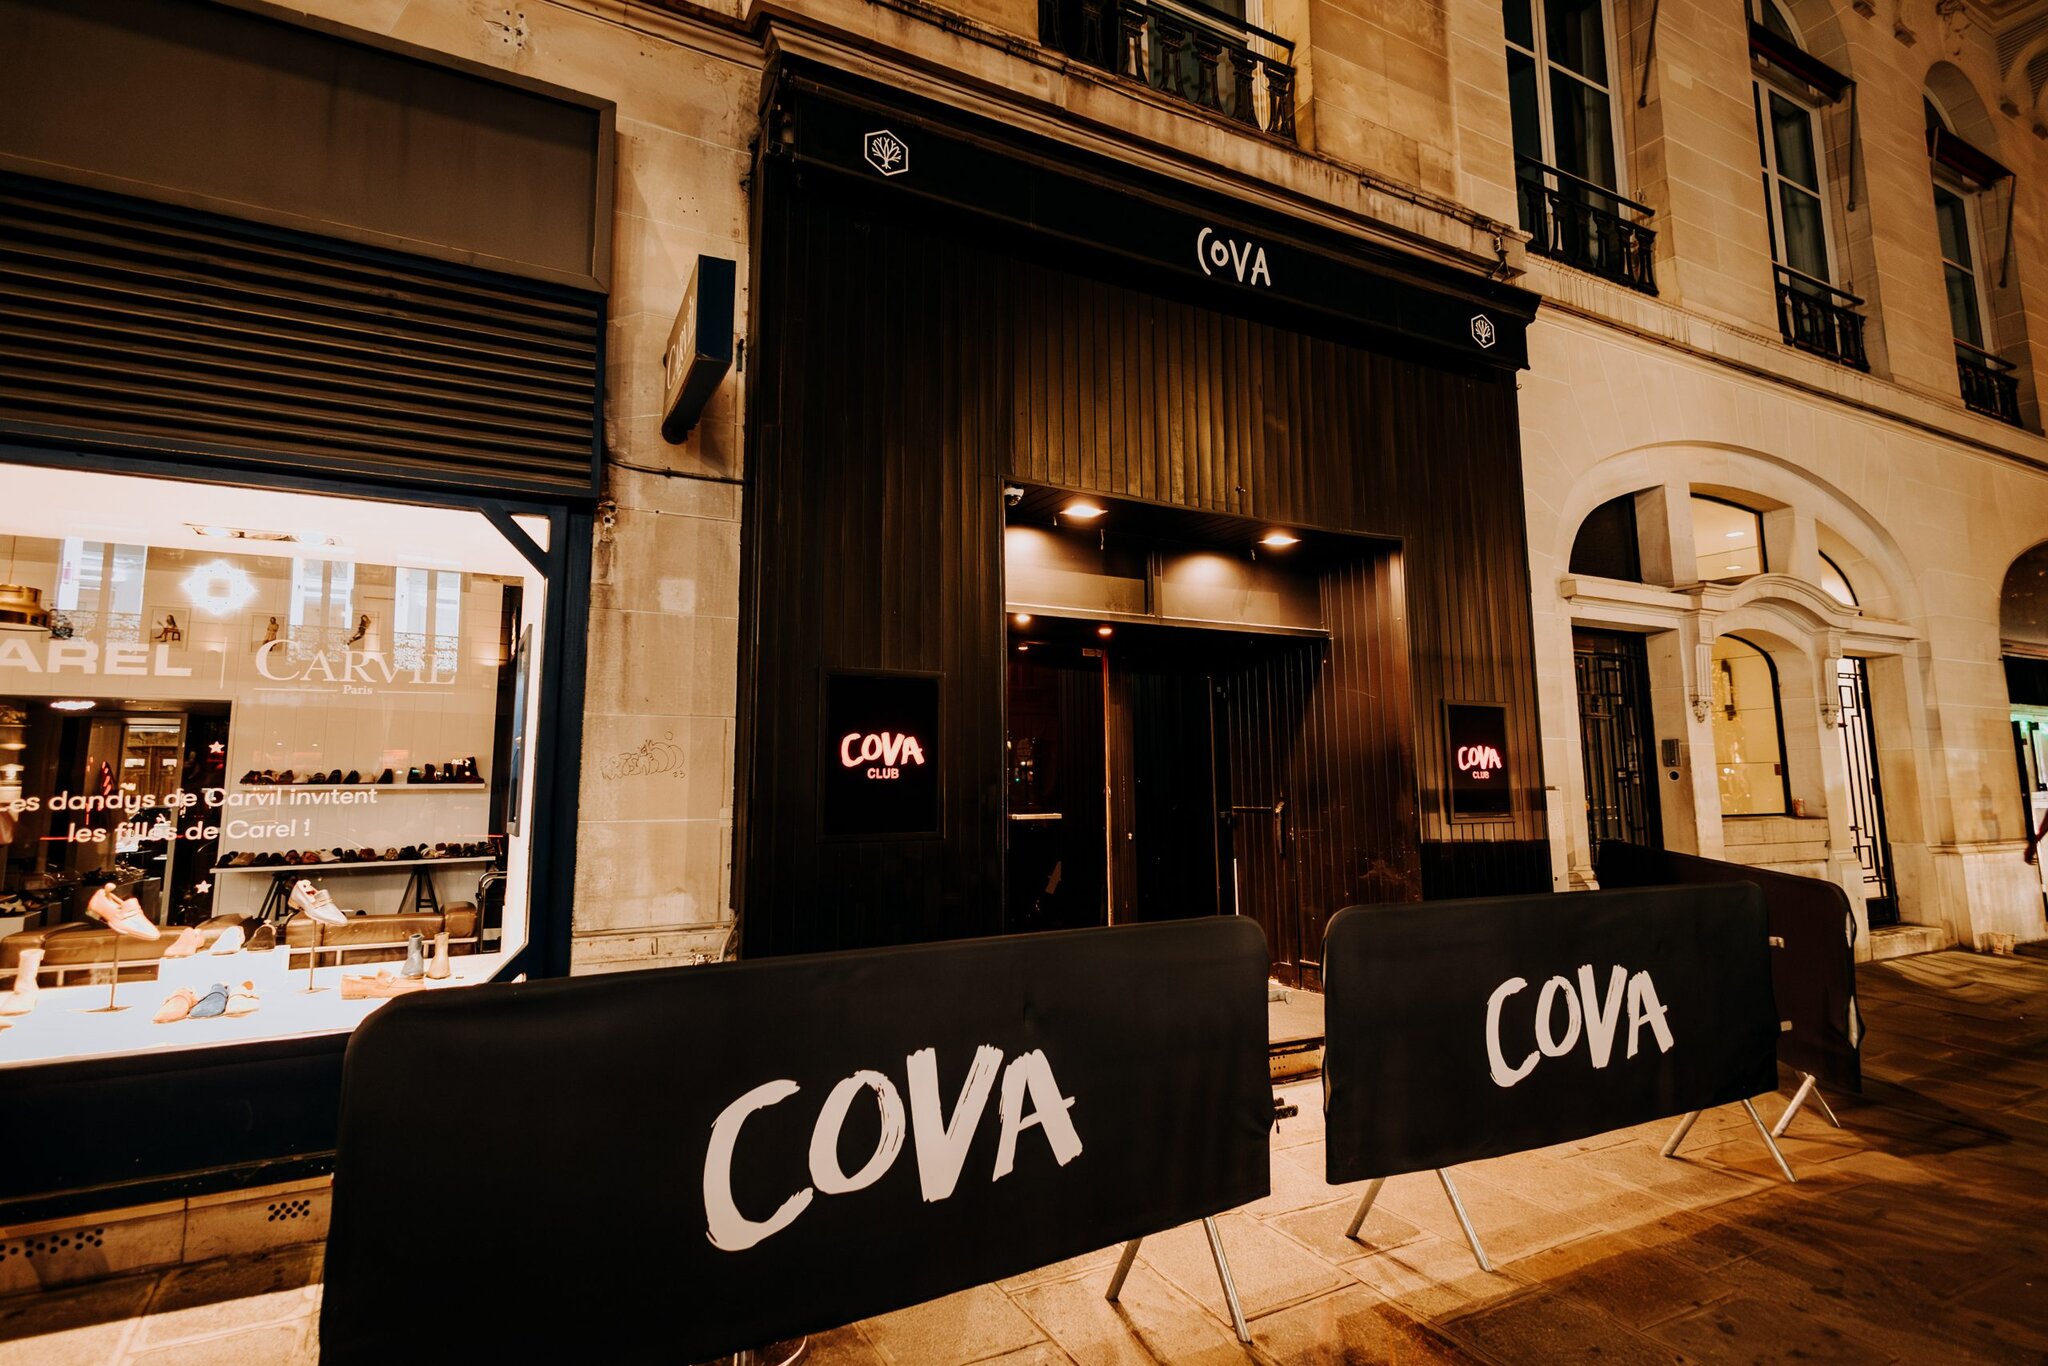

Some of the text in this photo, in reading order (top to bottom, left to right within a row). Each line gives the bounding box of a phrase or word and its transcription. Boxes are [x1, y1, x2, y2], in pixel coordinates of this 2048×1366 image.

[255, 639, 456, 685] CARVIL
[342, 684, 373, 695] Paris
[841, 731, 925, 767] COVA
[1458, 745, 1502, 771] COVA
[867, 767, 900, 779] CLUB
[1472, 771, 1490, 779] CLUB
[49, 790, 156, 814] dandys
[163, 788, 198, 807] de
[204, 787, 282, 807] Carvil
[289, 788, 378, 806] invitent
[68, 822, 107, 843] les
[114, 821, 178, 841] filles
[185, 820, 219, 840] de
[226, 819, 297, 839] Carel
[1486, 964, 1674, 1088] COVA
[703, 1044, 1084, 1252] COVA
